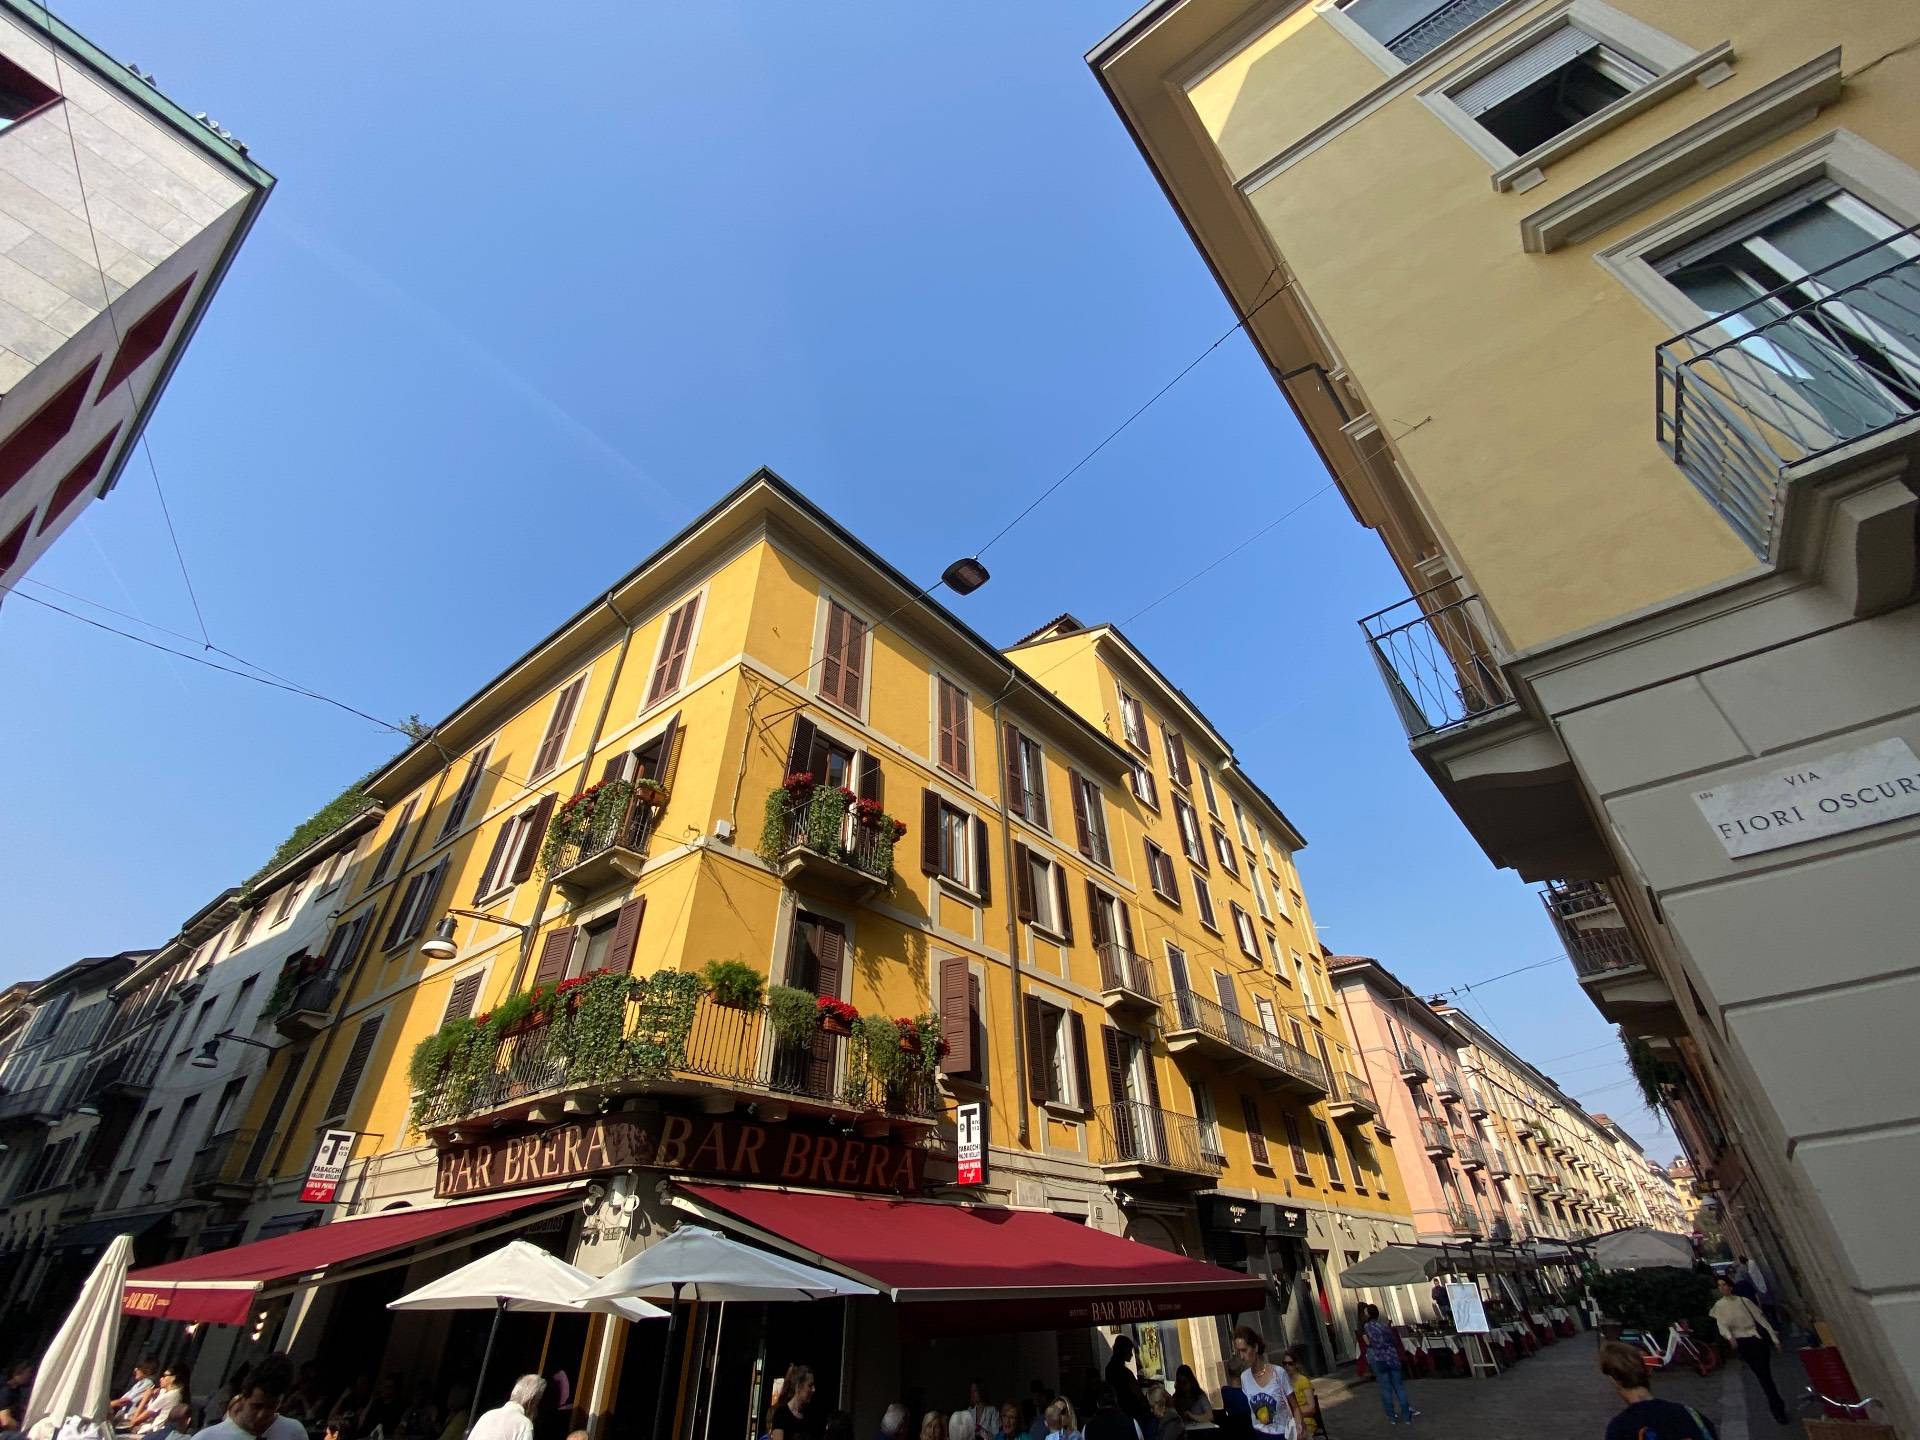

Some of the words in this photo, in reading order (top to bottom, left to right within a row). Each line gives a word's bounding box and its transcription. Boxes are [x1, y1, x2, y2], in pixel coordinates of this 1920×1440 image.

[1784, 771, 1822, 786] VIA
[1717, 806, 1806, 839] FIORI
[1818, 772, 1920, 814] OSCUR
[960, 1108, 977, 1143] T
[328, 1134, 352, 1165] T
[439, 1145, 492, 1194] BAR
[502, 1119, 612, 1184] BRERA
[653, 1115, 767, 1175] BAR
[781, 1132, 916, 1190] BRERA
[313, 1166, 344, 1174] TABACCHI
[1091, 1302, 1116, 1321] BAR
[1119, 1300, 1155, 1319] BRERA
